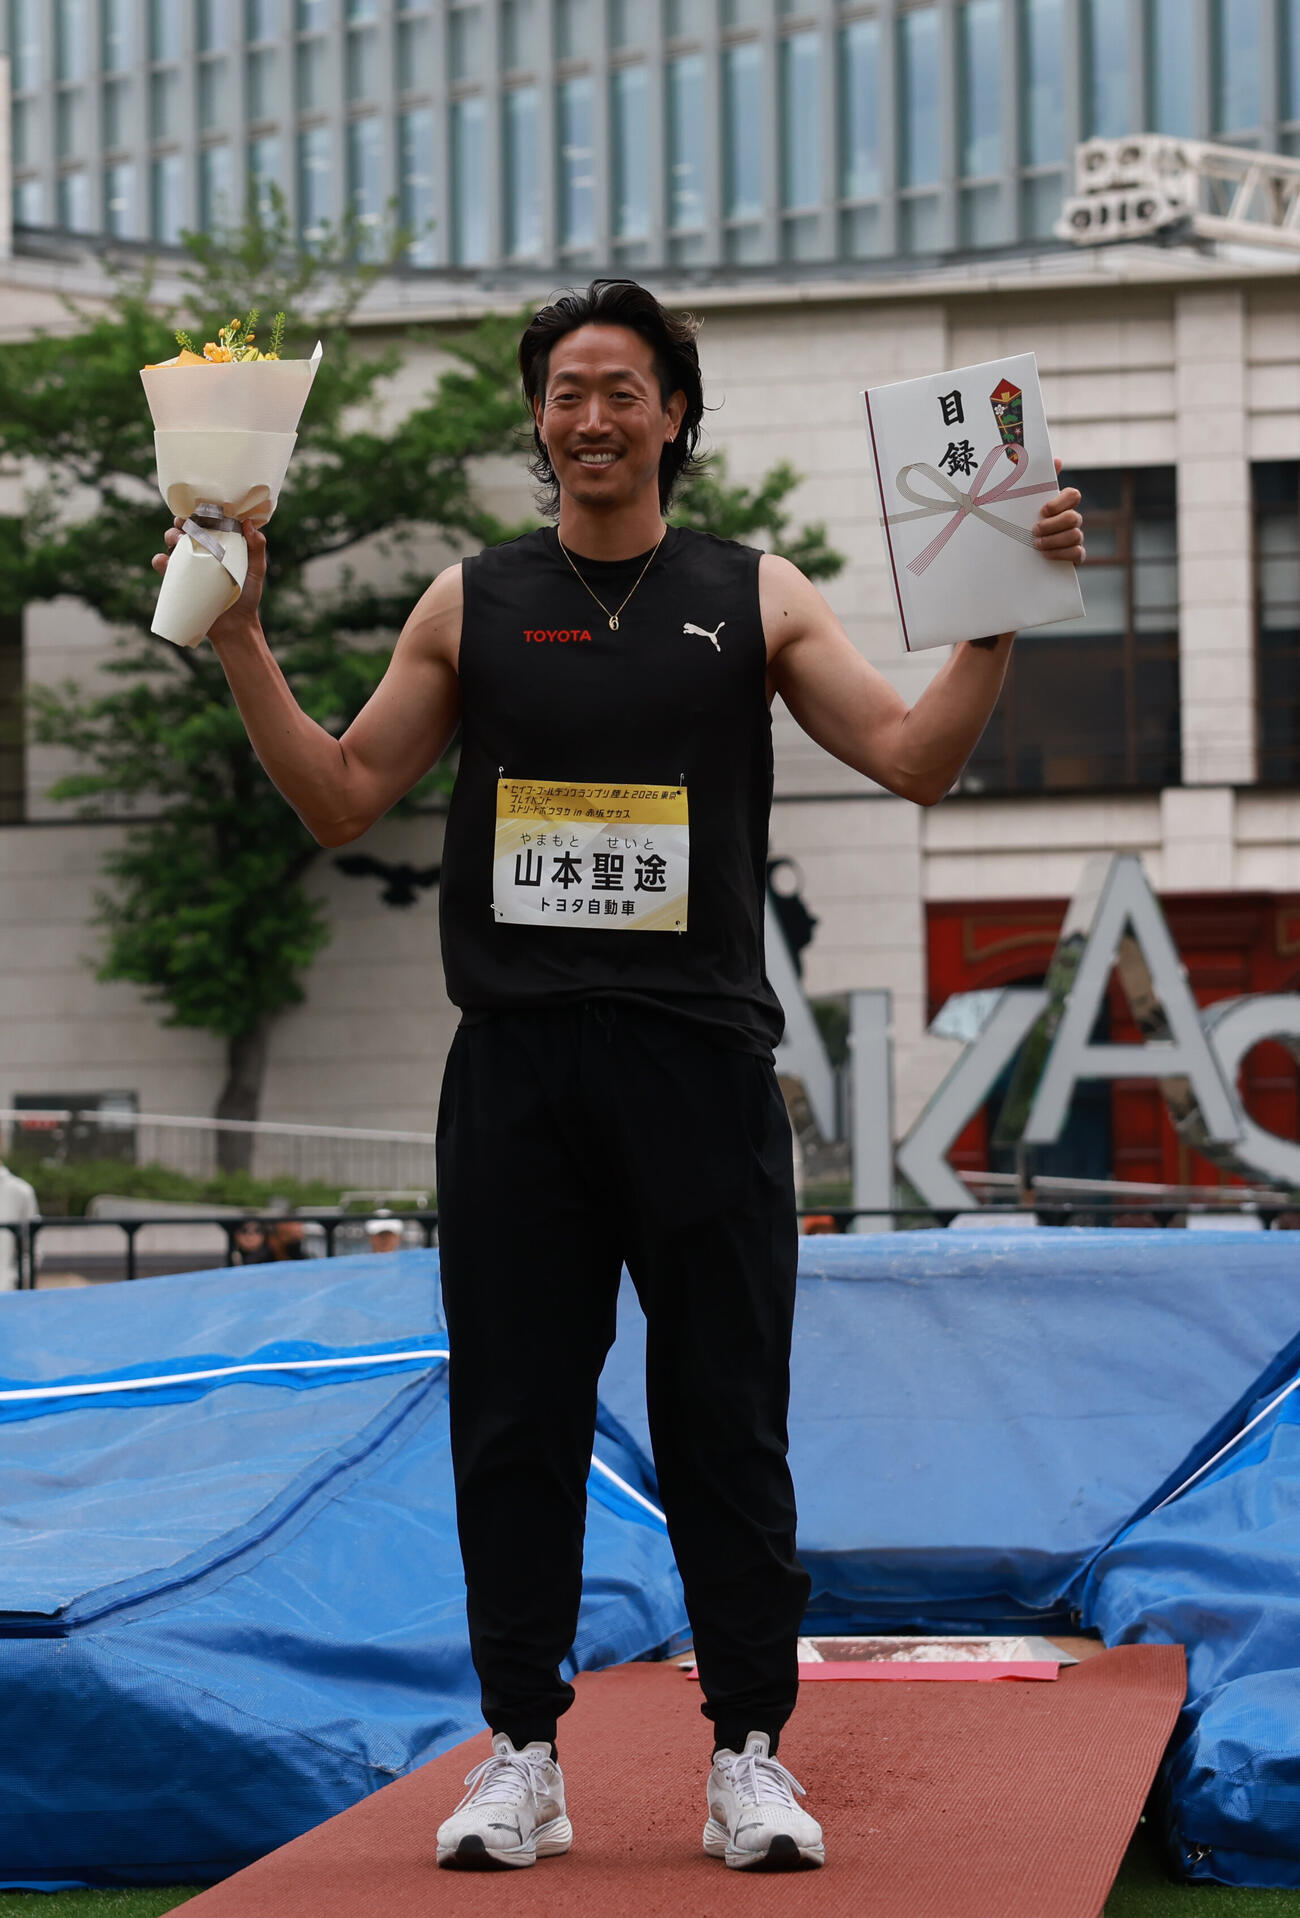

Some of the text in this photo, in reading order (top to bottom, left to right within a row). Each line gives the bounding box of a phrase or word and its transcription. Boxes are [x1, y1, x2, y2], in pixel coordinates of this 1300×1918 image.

[937, 389, 979, 477] 目録
[523, 629, 592, 643] TOYOTA
[573, 808, 583, 816] in
[520, 832, 655, 850] やまもと せいと
[514, 848, 667, 892] 山本聖途
[541, 897, 635, 916] トヨタ自動車
